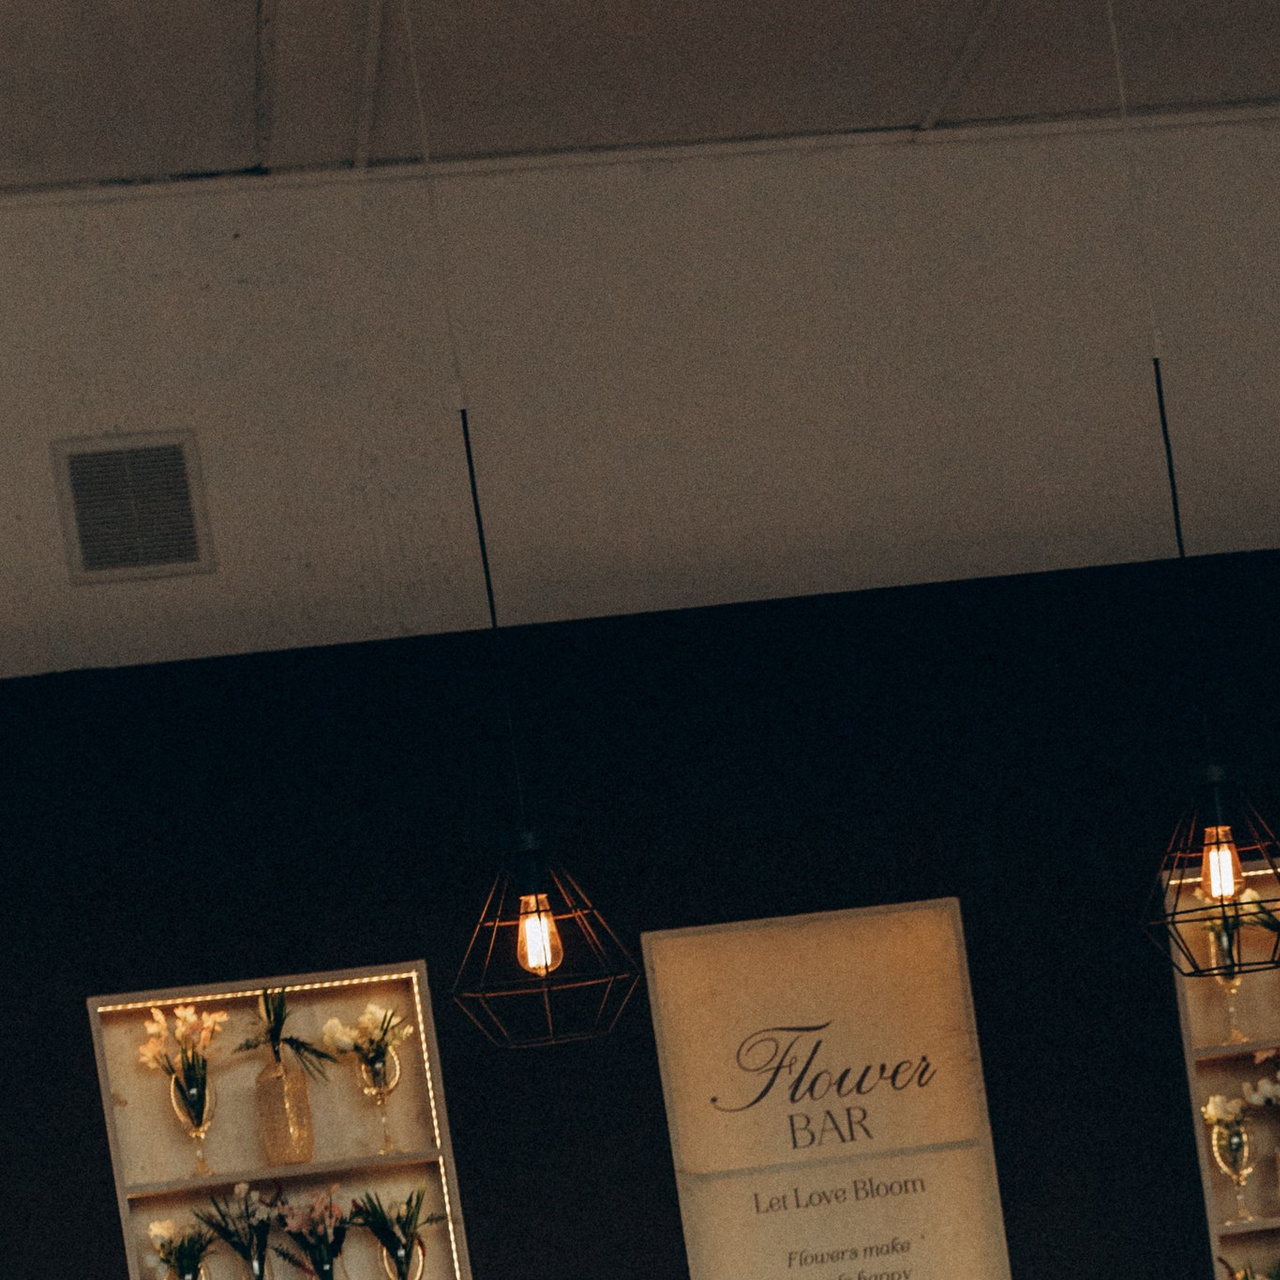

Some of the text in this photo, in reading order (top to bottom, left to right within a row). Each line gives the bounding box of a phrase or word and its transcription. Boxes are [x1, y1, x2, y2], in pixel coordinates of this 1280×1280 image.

[710, 1020, 937, 1113] Flower
[788, 1105, 874, 1150] BAR
[754, 1176, 926, 1214] Let Love Bloom
[787, 1236, 911, 1269] Flowers make
